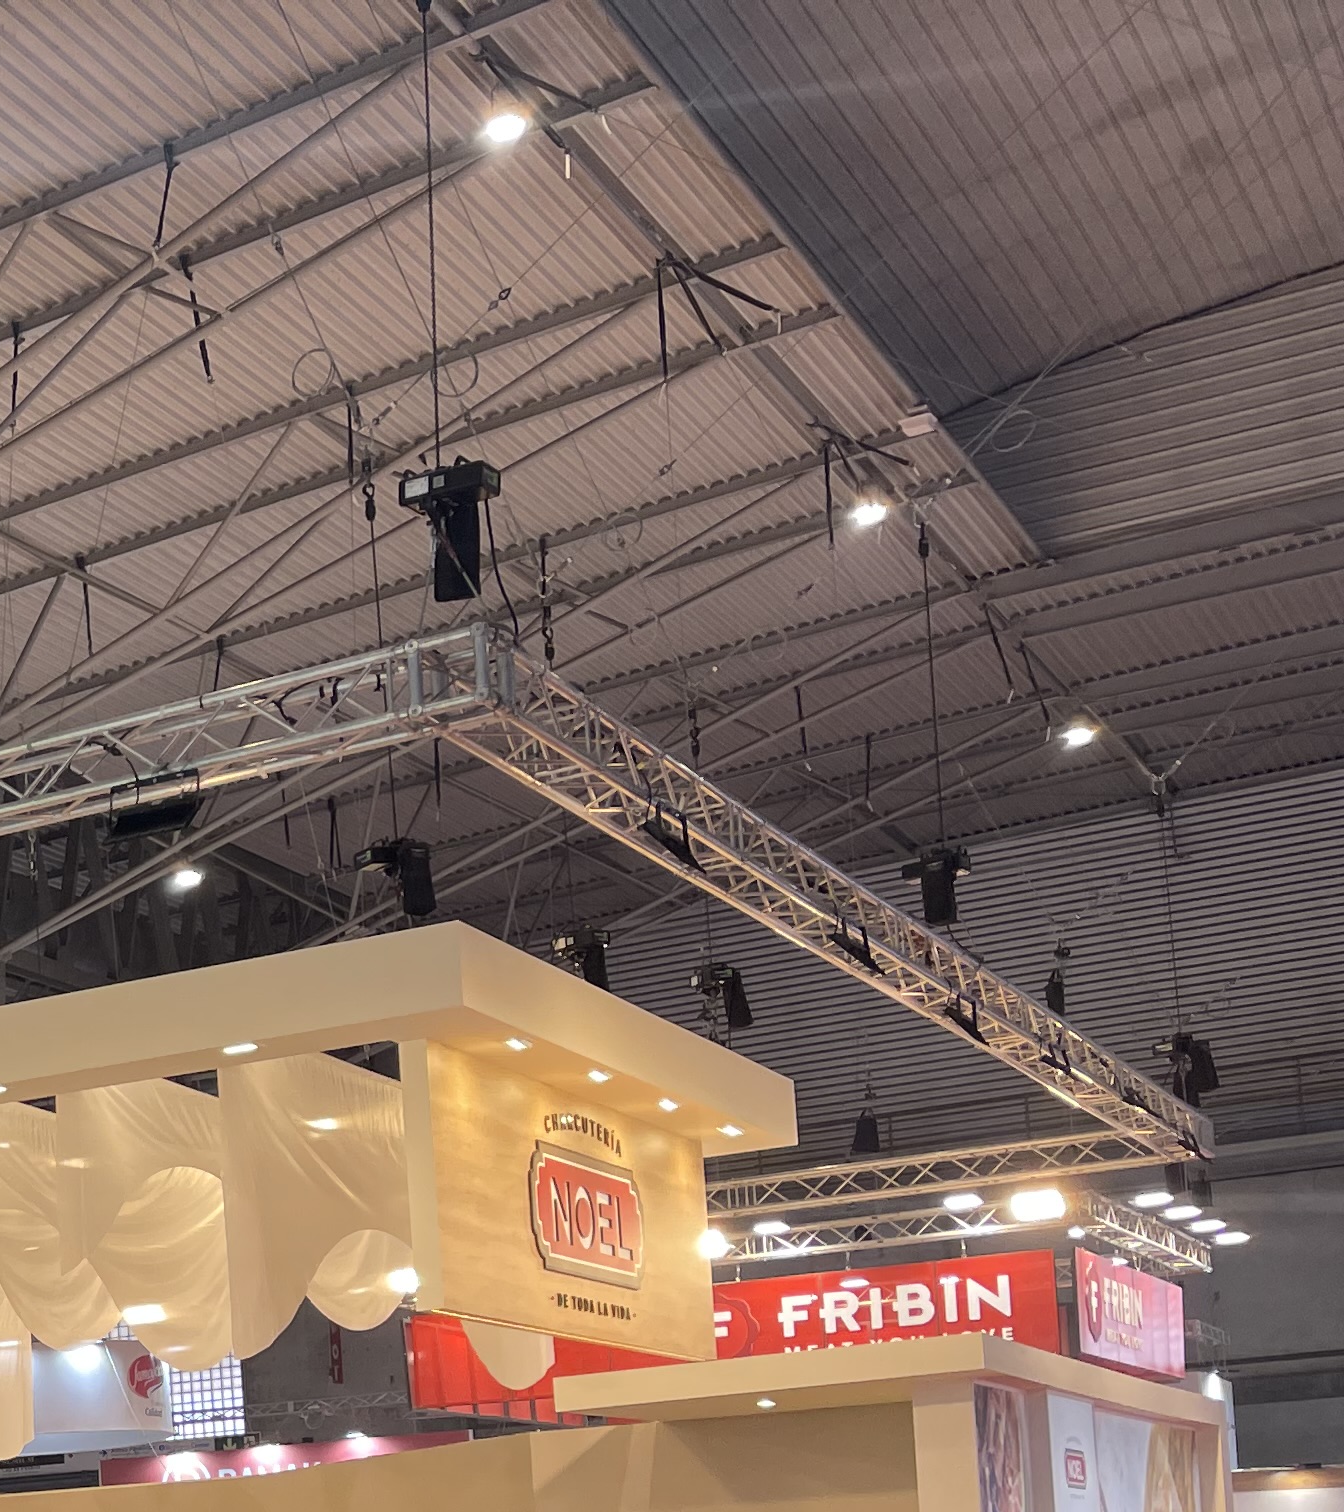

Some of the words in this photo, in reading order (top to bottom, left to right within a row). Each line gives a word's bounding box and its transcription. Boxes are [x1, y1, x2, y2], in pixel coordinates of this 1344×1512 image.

[550, 1175, 634, 1261] NOEL
[557, 1292, 569, 1309] DE
[597, 1302, 609, 1317] LA
[778, 1274, 1012, 1338] FRIBIN
[1103, 1277, 1143, 1330] FRIBIN
